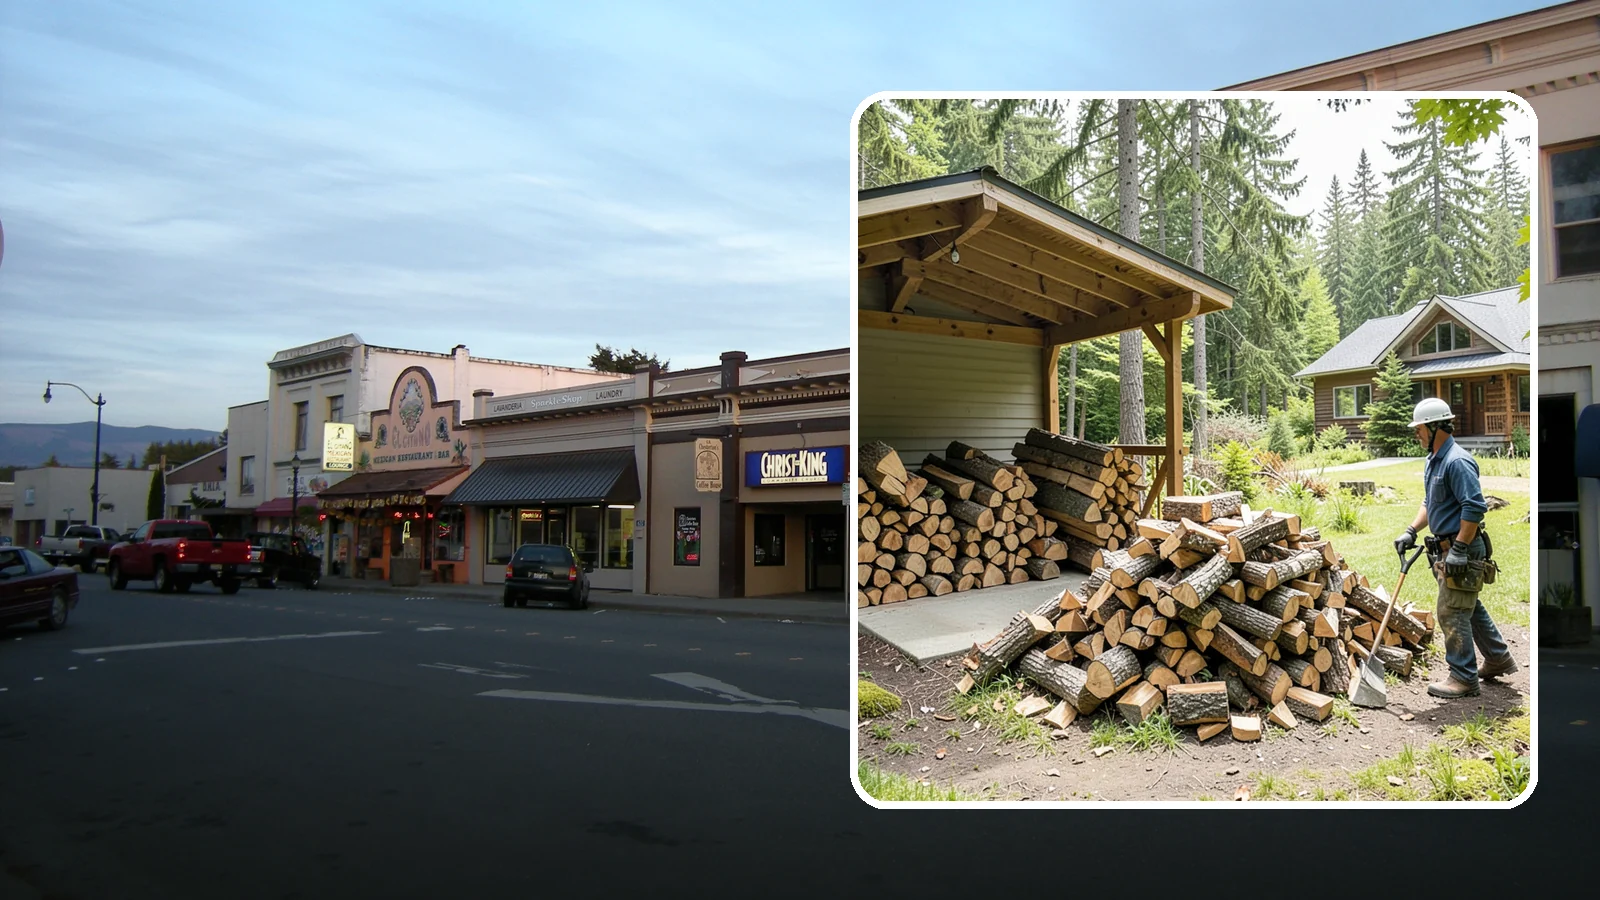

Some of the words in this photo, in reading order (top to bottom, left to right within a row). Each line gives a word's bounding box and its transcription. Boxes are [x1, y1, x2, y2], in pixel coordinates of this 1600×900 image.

[493, 401, 523, 413] LAVANDERIA
[530, 396, 560, 408] Sparkle
[562, 394, 582, 405] Shop
[595, 388, 623, 400] LAUNDRY
[373, 455, 396, 464] MEXICAN
[397, 451, 434, 463] RESTAURANT
[437, 450, 450, 459] BAR
[761, 452, 797, 478] CHRIST
[799, 450, 827, 476] KING
[696, 480, 709, 489] Coffee
[710, 480, 722, 489] House
